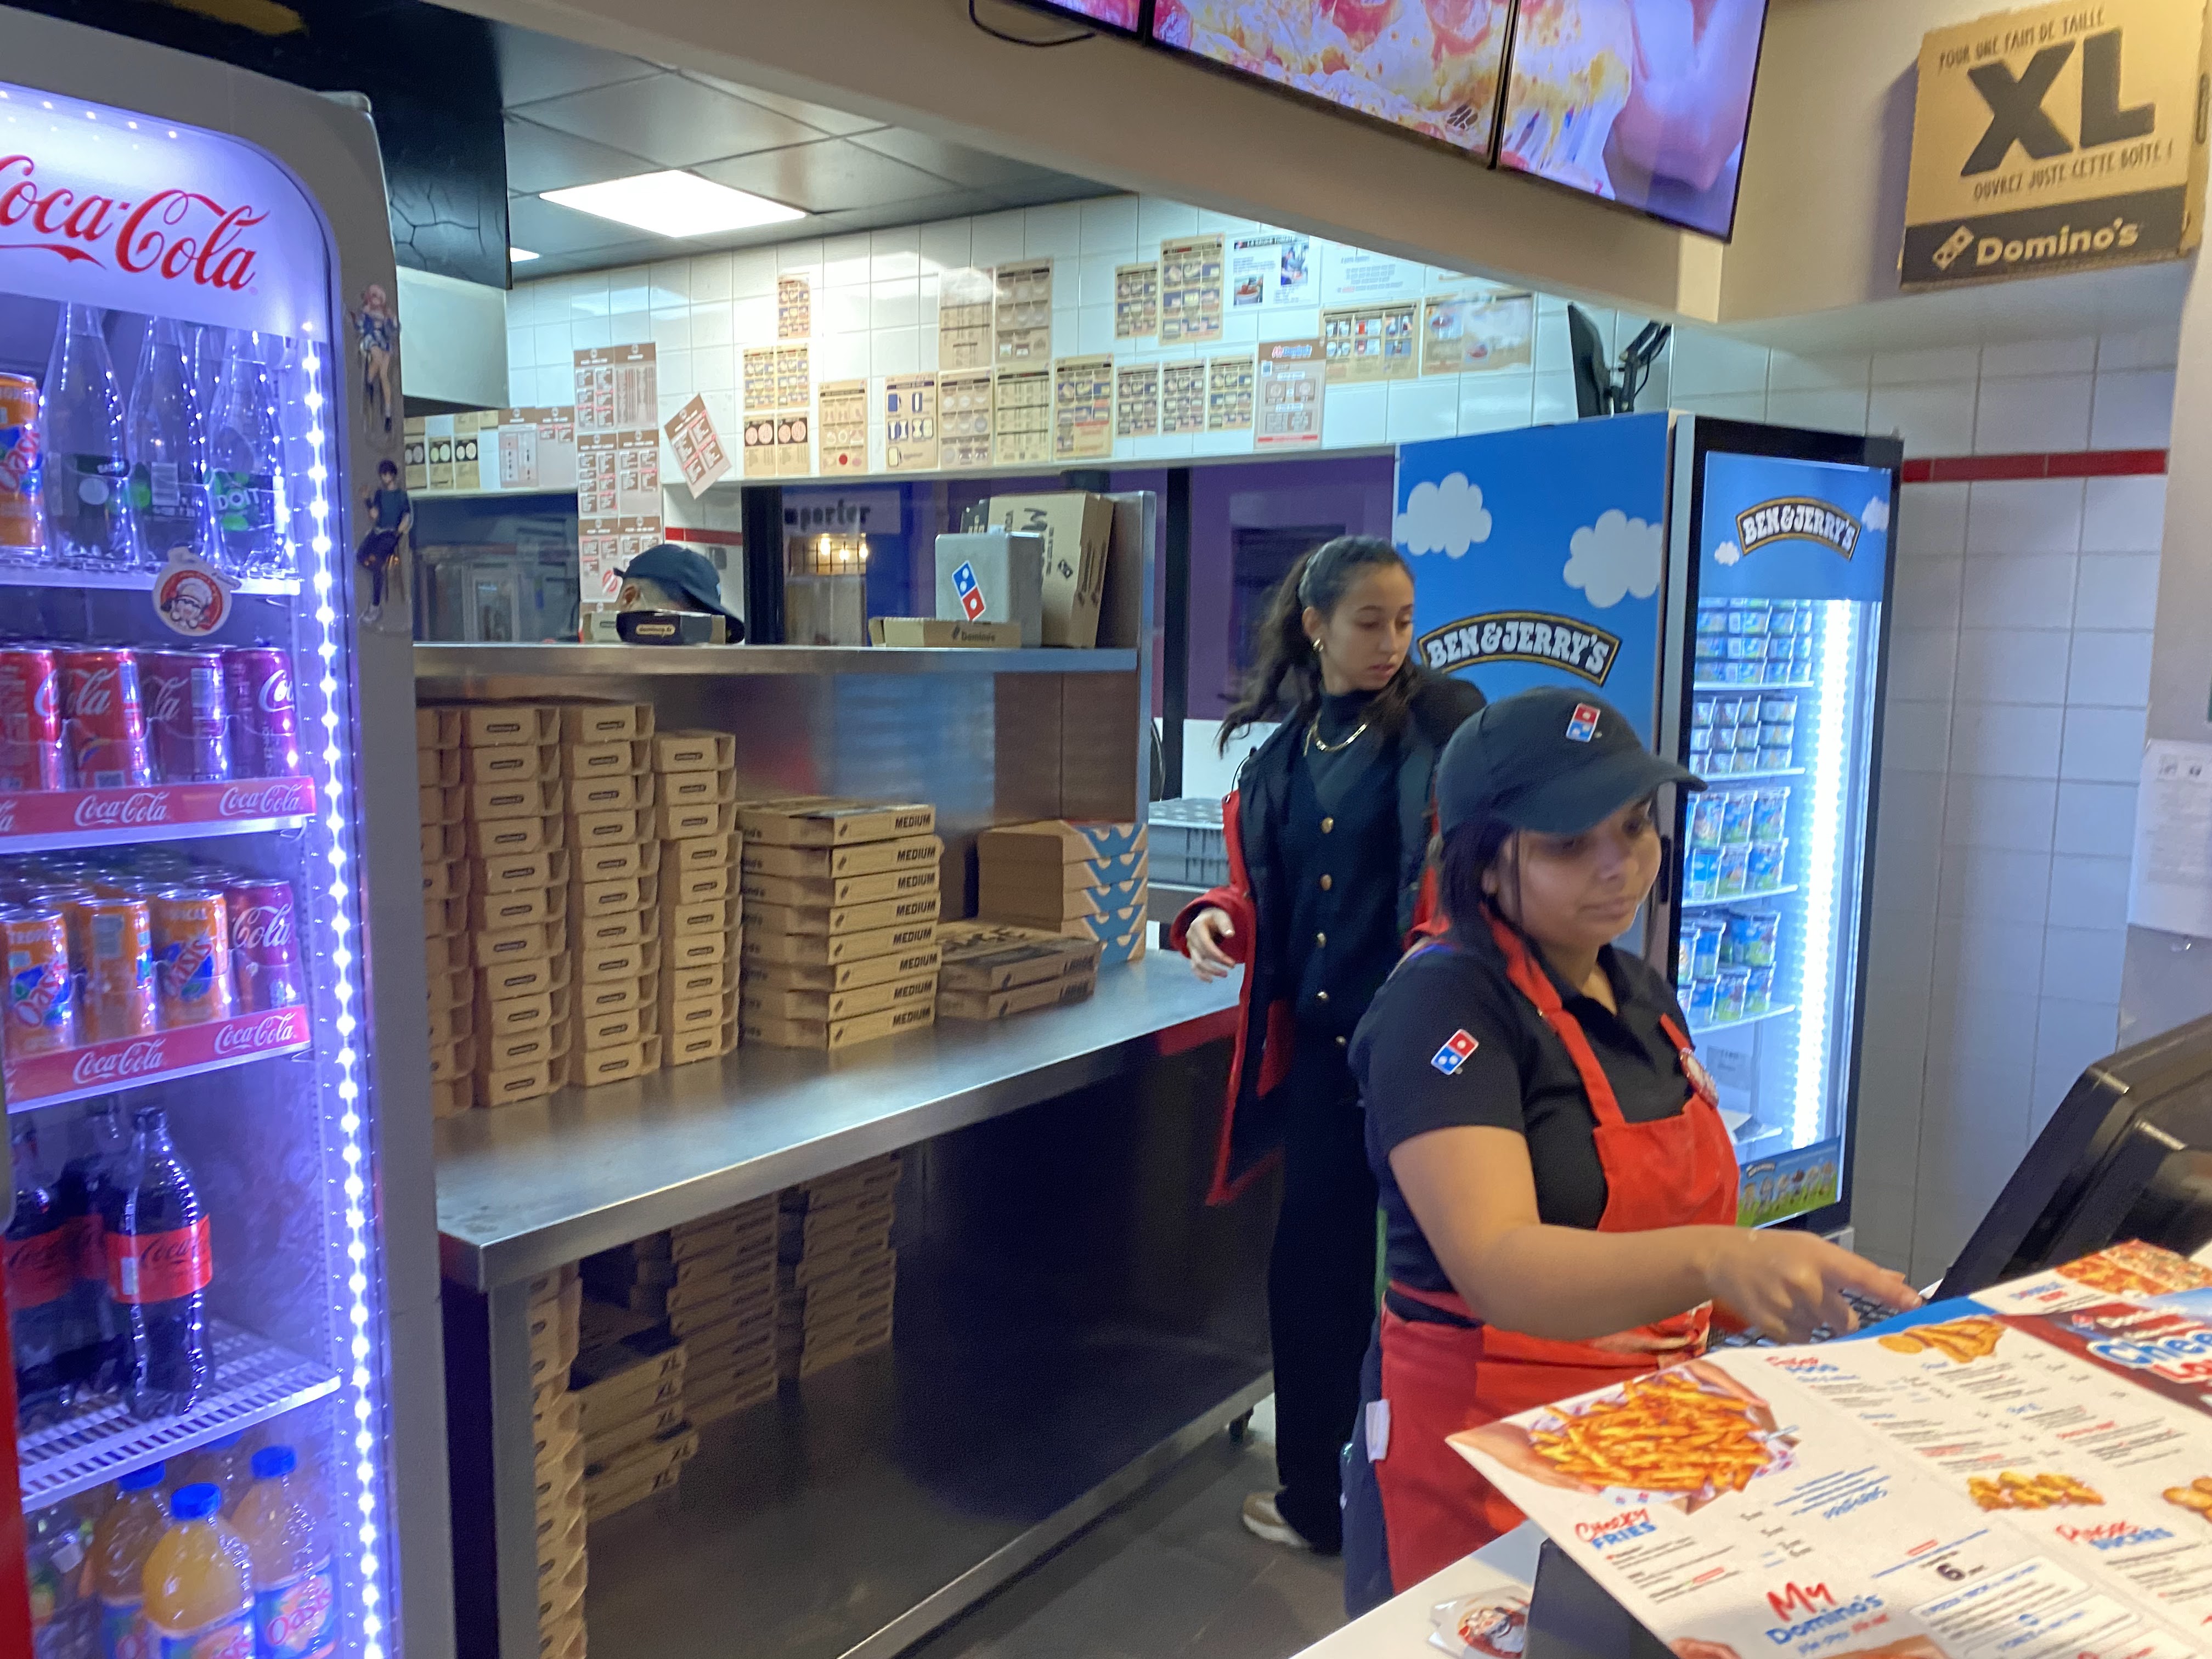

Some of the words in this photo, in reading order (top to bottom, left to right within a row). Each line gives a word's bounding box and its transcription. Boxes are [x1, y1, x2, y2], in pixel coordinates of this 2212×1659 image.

[1976, 38, 1999, 58] UNE
[2039, 21, 2055, 40] DE
[2062, 8, 2105, 35] TAILLE
[1960, 27, 2155, 177] XL
[1973, 174, 2023, 201] OUVREZ
[2029, 166, 2066, 190] JUSTE
[2072, 153, 2115, 178] CETTE
[1976, 217, 2138, 266] Domino's
[213, 487, 260, 511] DOIT
[784, 499, 871, 532] mporter
[1427, 620, 1609, 675] BEN&JERRY'S
[74, 791, 170, 826] Coca-Cola
[219, 782, 303, 816] Coca-Cola
[895, 813, 931, 830] MEDIUM
[896, 847, 936, 862] MEDIUM
[898, 872, 935, 889] MEDIUM
[896, 899, 936, 916] MEDIUM
[893, 928, 932, 945] MEDIUM
[899, 952, 938, 971] MEDIUM
[894, 980, 933, 1000] MEDIUM
[214, 1012, 297, 1054] Coca-Cola
[893, 1007, 931, 1026] MEDIUM
[72, 1037, 166, 1084] Coca-Cola
[1767, 1582, 1837, 1622] My
[1765, 1594, 1884, 1645] Domino's
